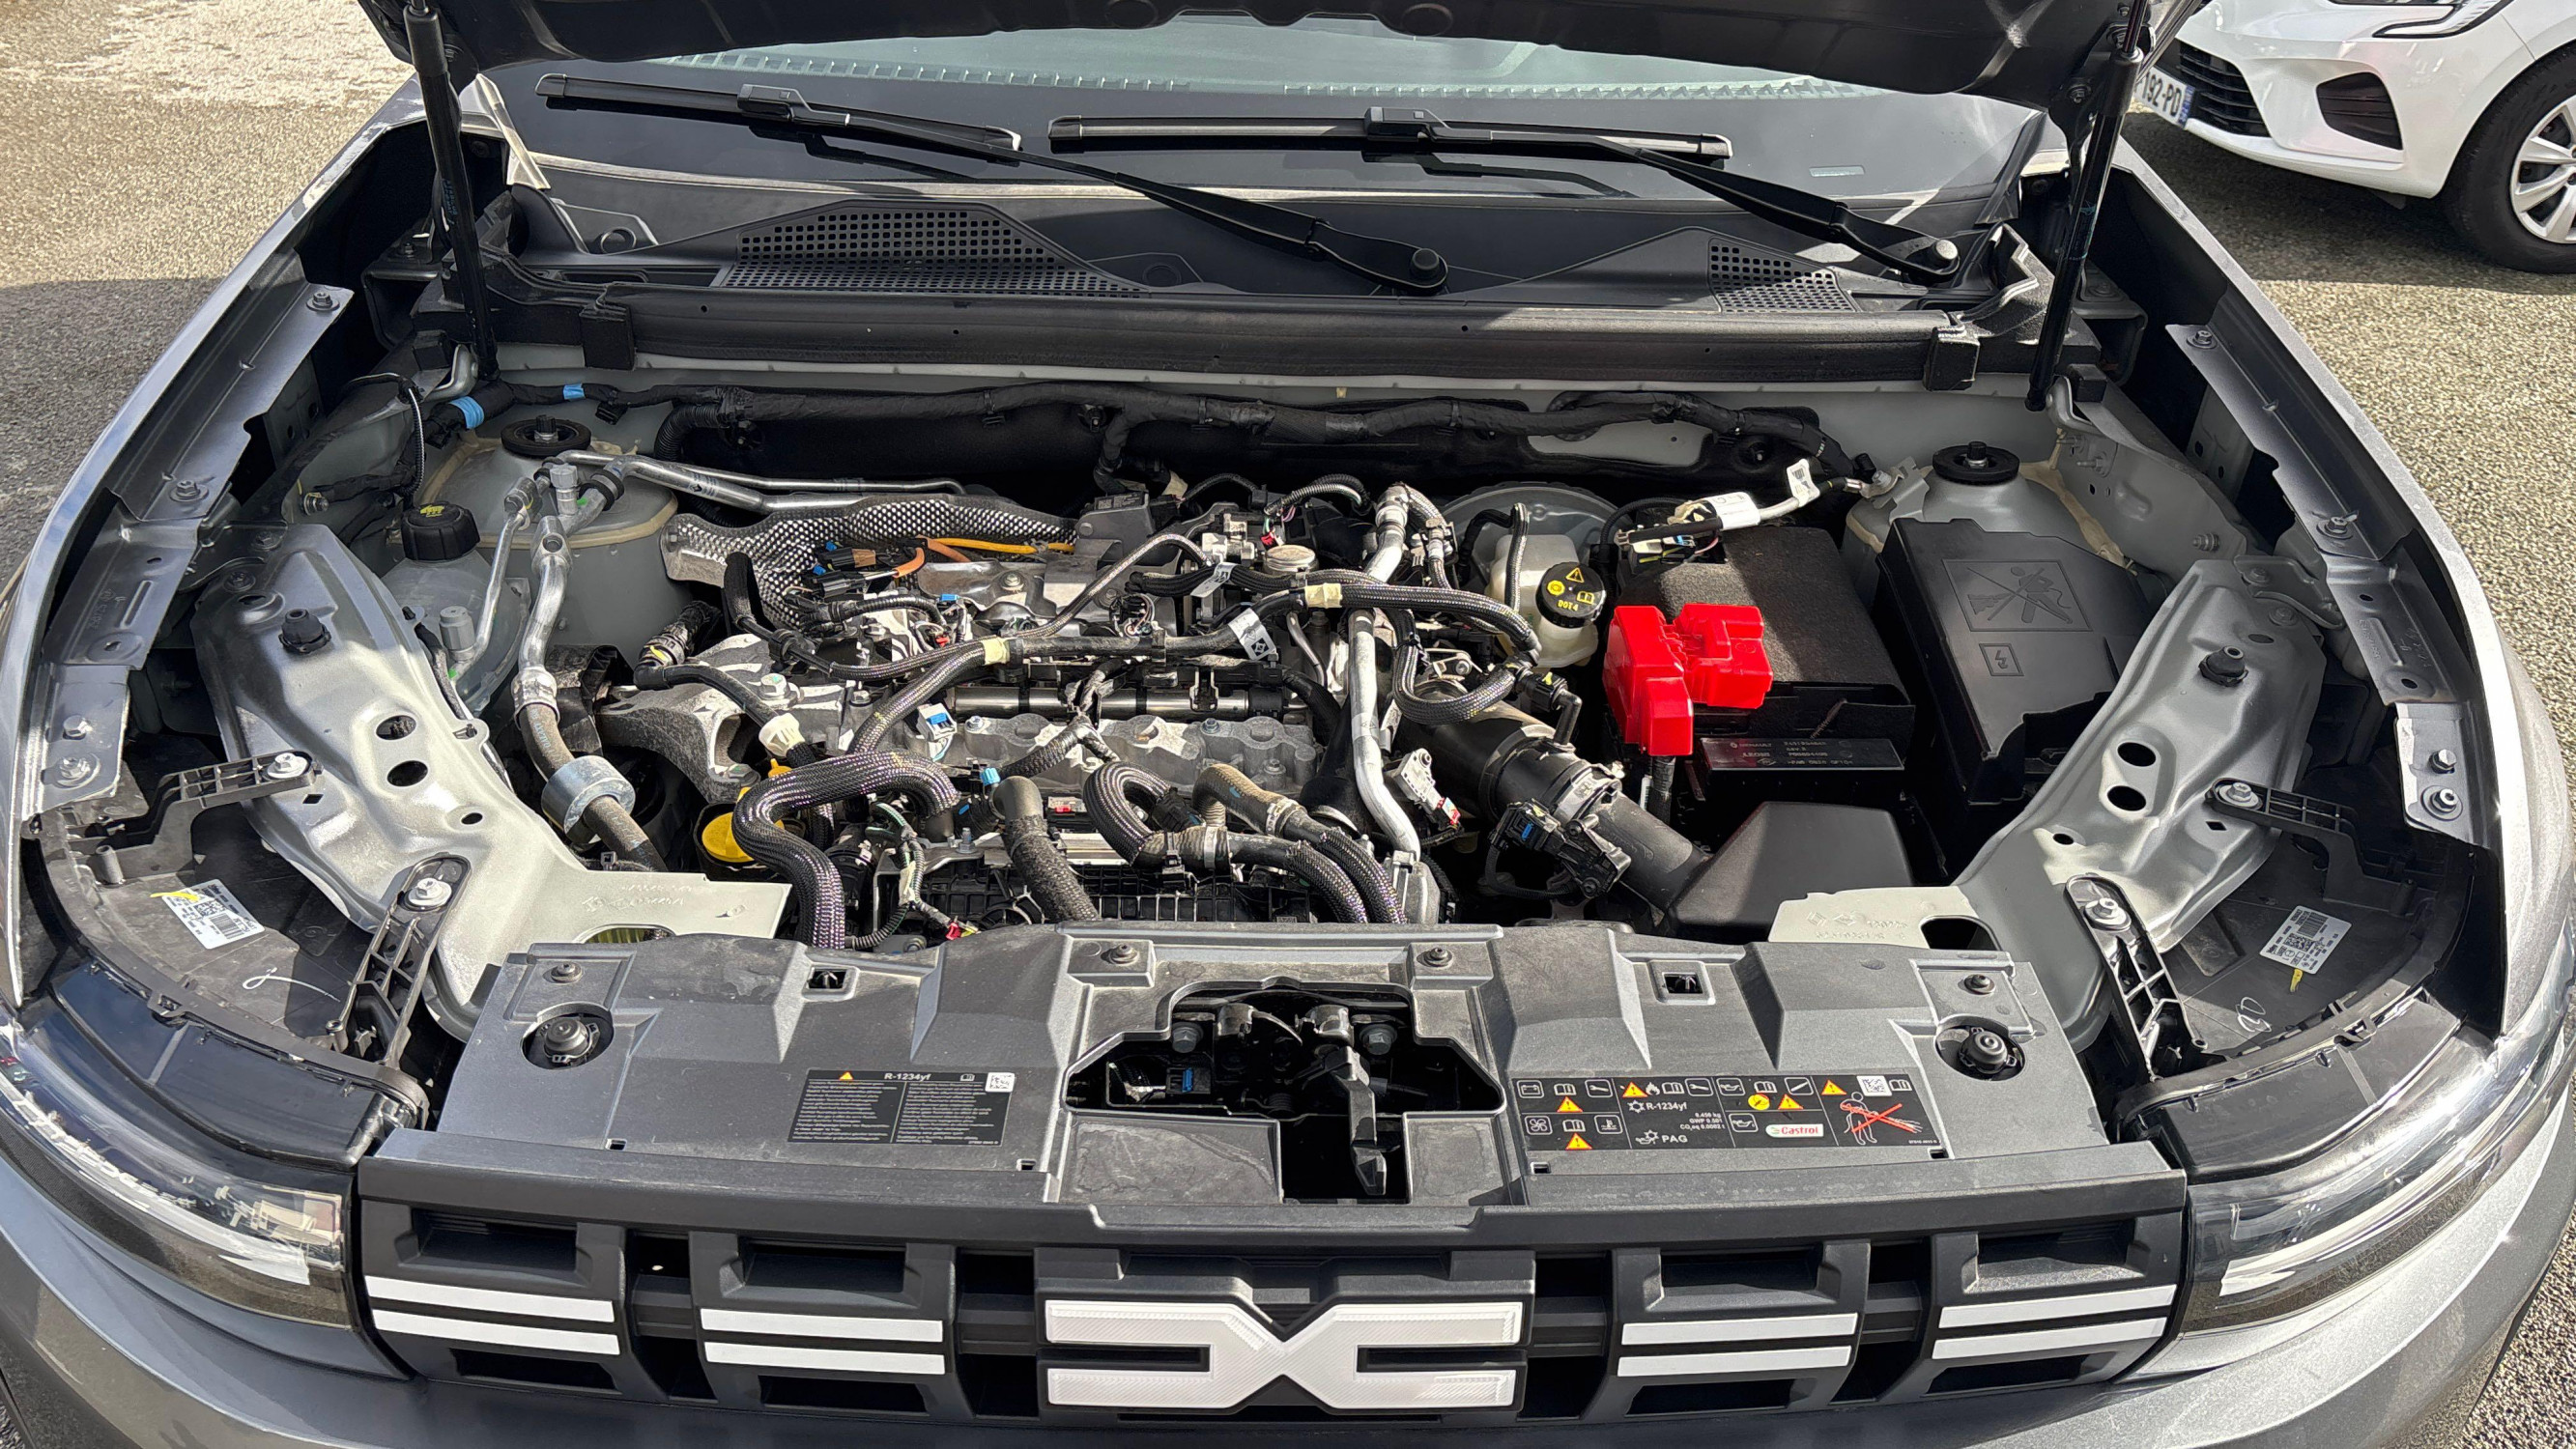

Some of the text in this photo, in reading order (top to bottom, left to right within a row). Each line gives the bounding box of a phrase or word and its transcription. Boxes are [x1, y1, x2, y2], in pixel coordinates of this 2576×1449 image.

[884, 1072, 931, 1081] R-1234yf
[1646, 1101, 1688, 1111] R-1234yf
[1781, 1126, 1818, 1135] Castrol
